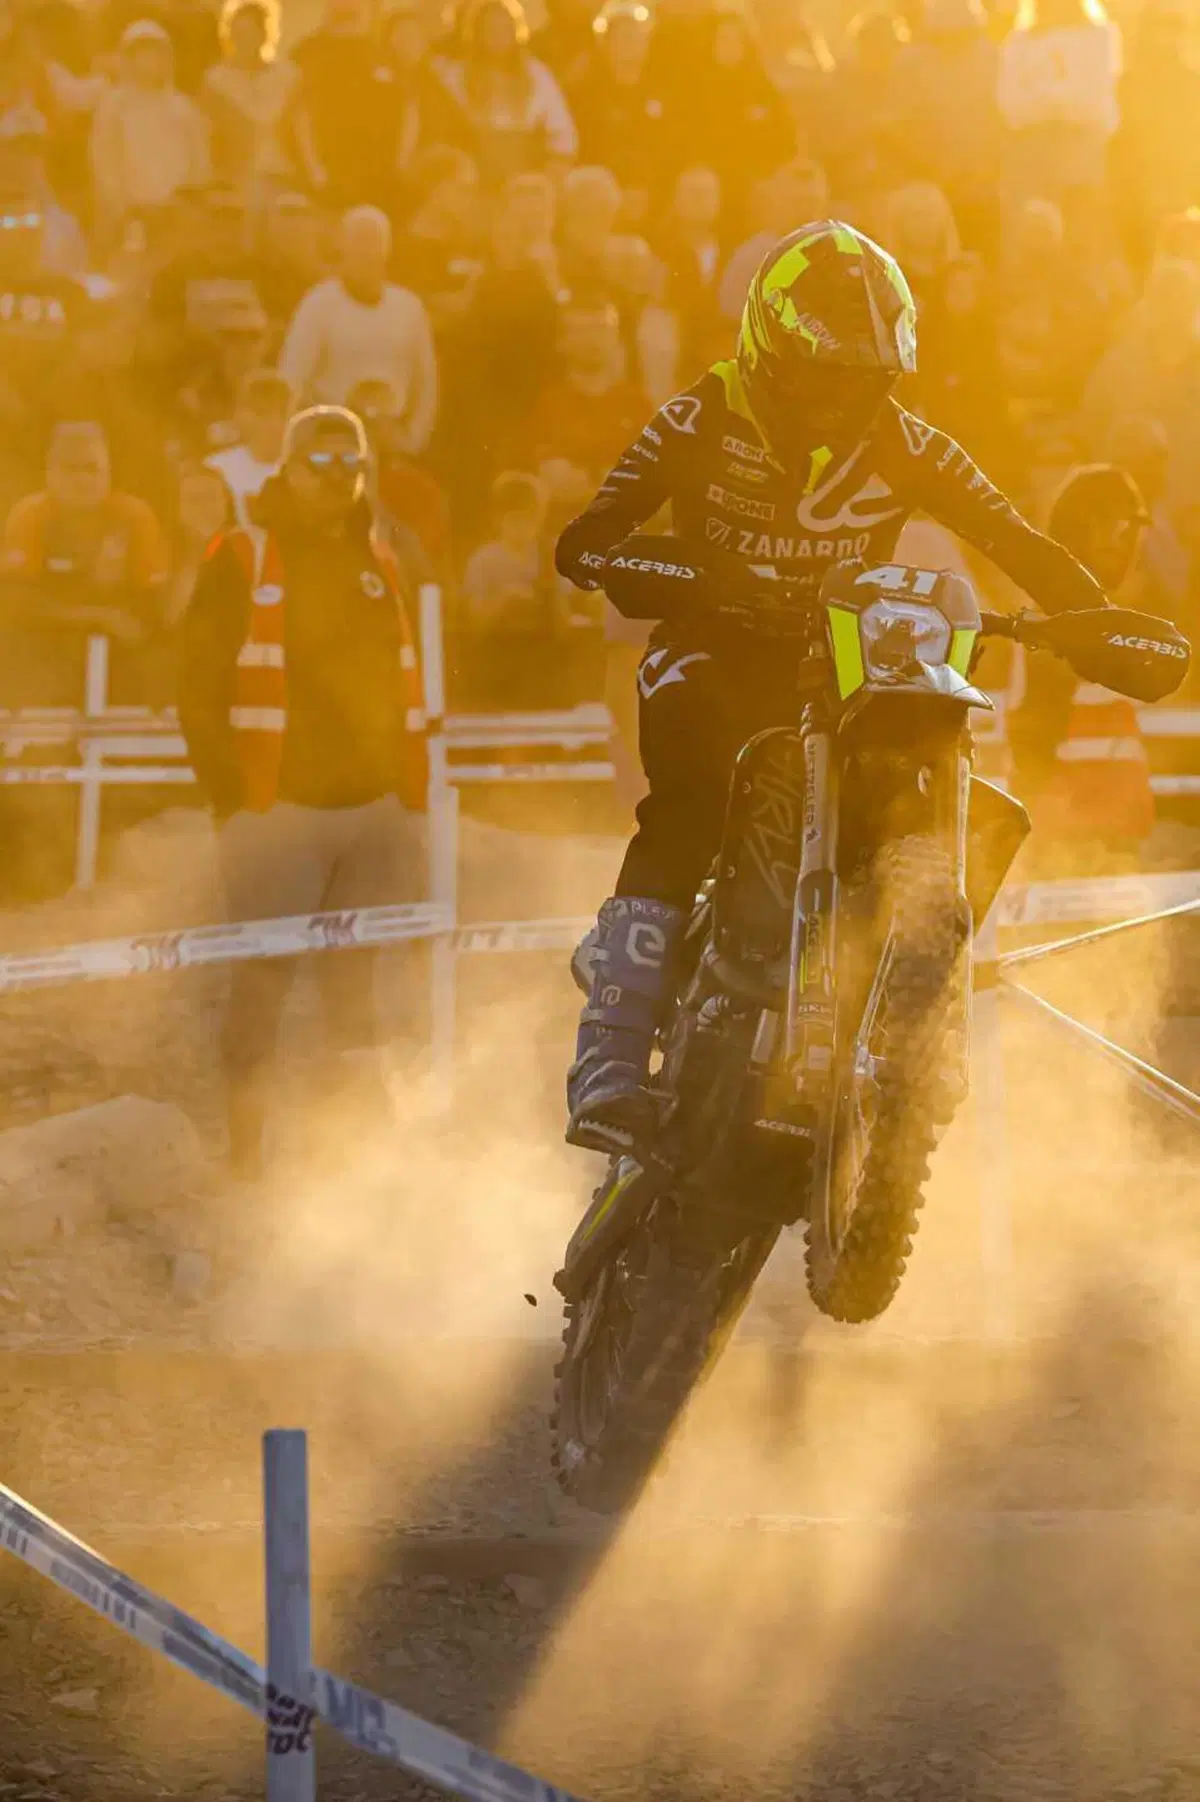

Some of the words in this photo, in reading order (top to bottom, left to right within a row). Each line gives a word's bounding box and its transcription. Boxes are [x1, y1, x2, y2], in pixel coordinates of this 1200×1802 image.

[611, 556, 696, 580] ACERBIS
[854, 565, 938, 595] 41
[1108, 634, 1187, 659] ACERBIS
